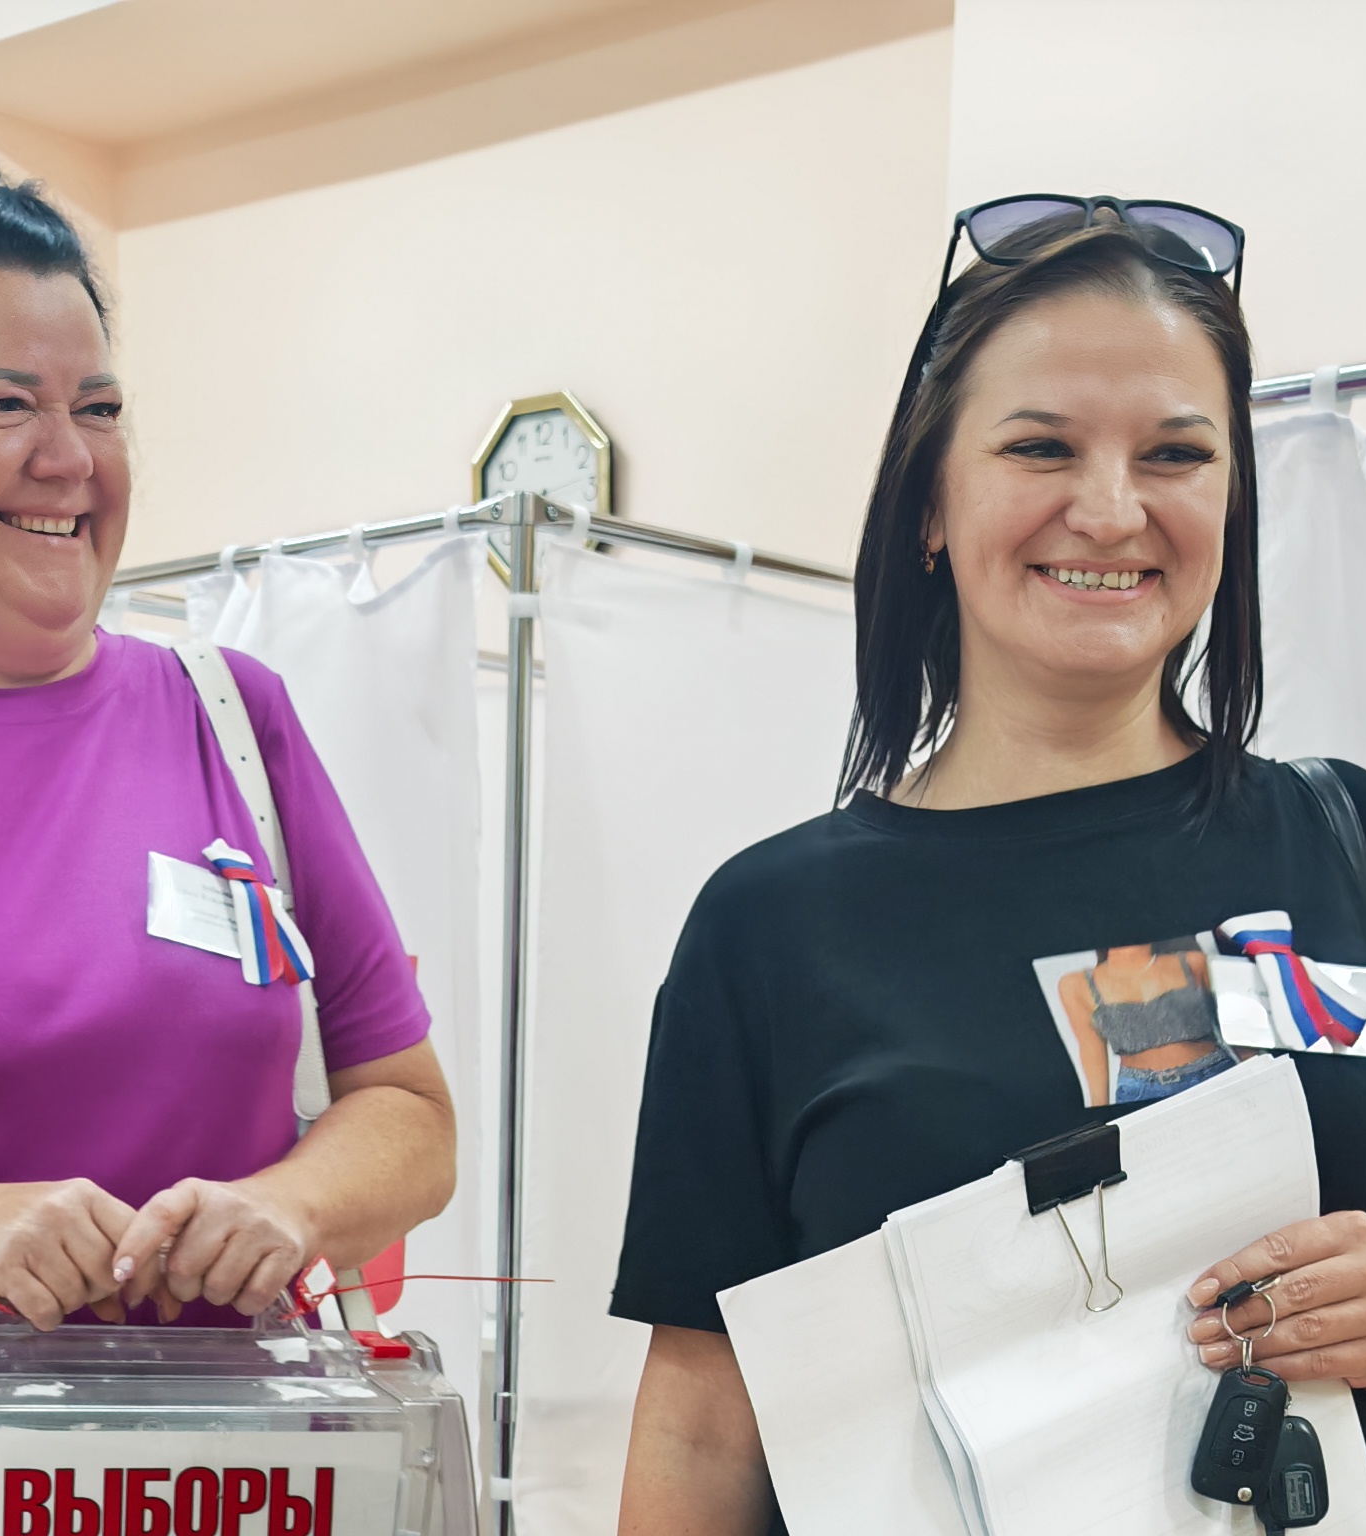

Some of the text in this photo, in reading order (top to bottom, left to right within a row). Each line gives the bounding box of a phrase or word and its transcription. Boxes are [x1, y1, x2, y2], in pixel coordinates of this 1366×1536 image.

[535, 420, 553, 447] 12
[575, 444, 590, 470] 2
[498, 460, 518, 482] 10
[583, 475, 597, 502] 3
